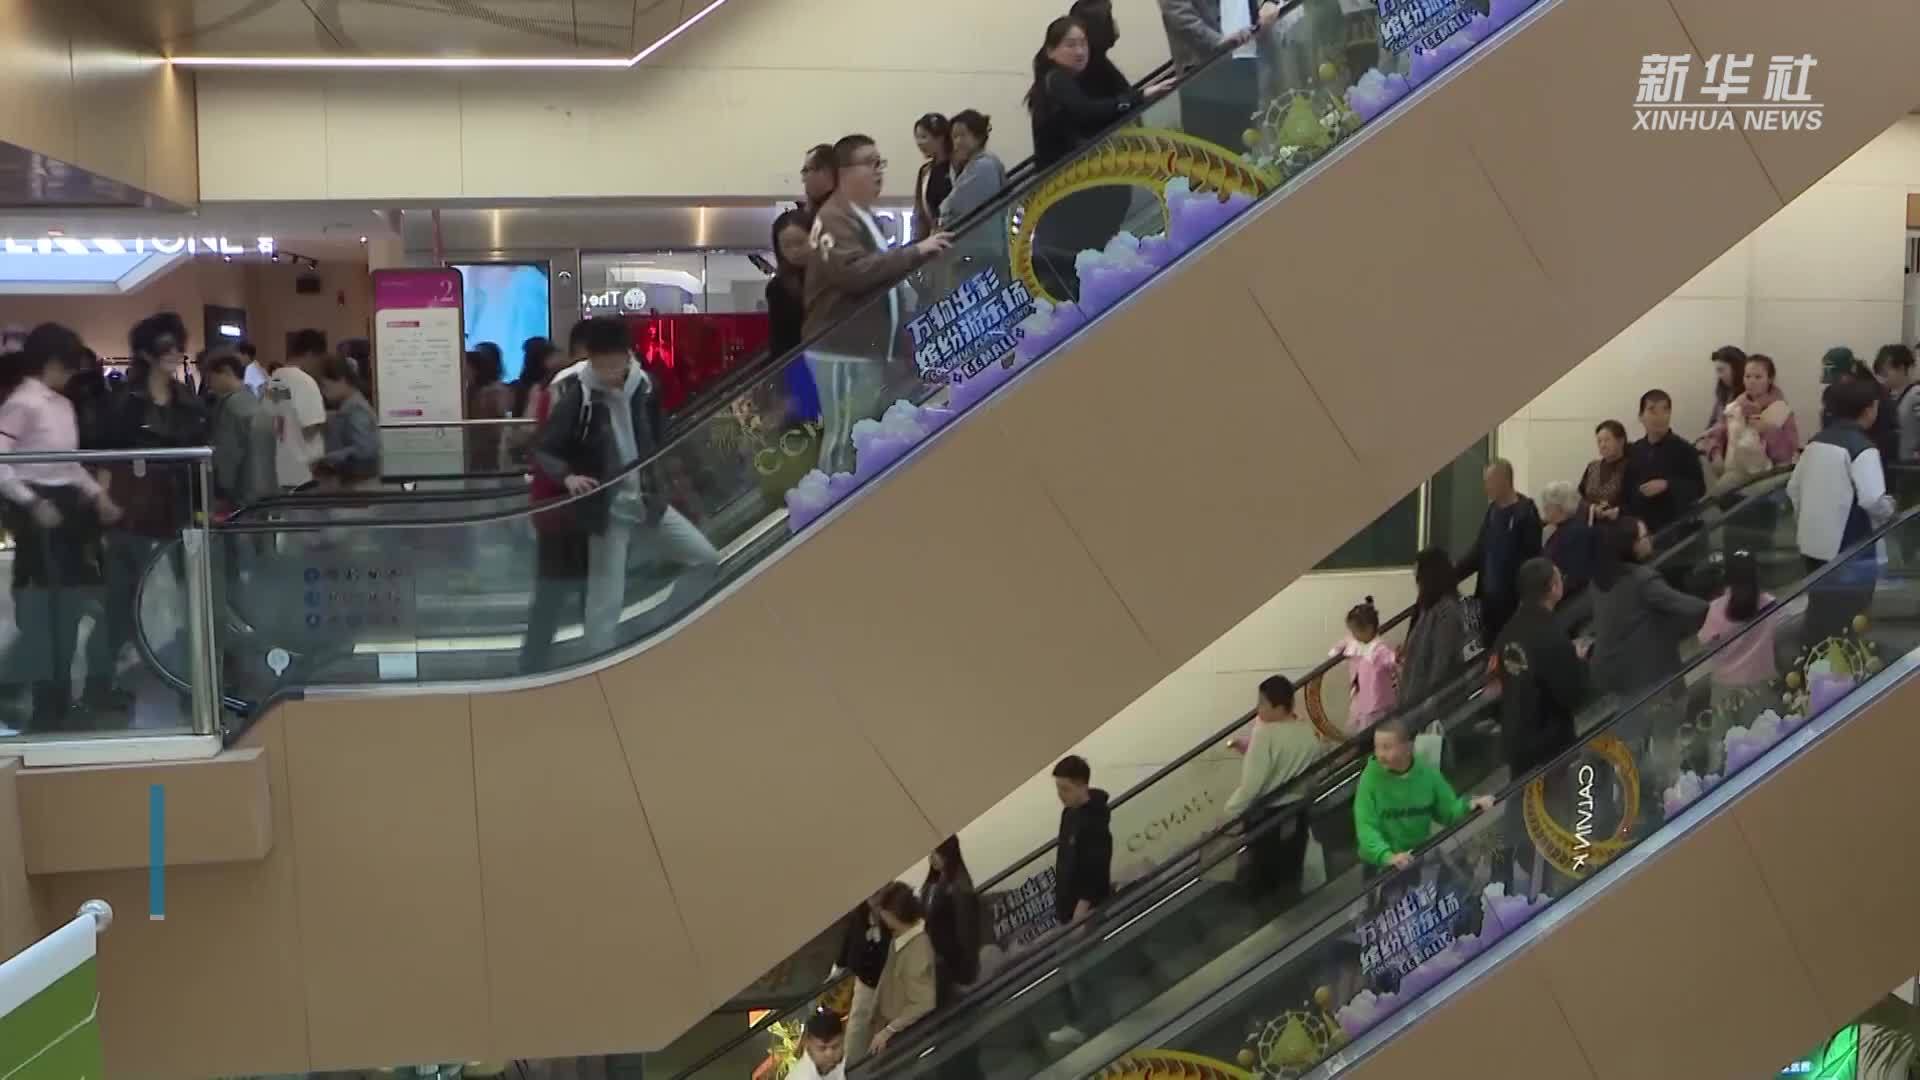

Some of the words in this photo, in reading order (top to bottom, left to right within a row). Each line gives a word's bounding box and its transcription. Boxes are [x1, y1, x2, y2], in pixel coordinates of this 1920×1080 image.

[905, 266, 1000, 345] 万物出彩
[914, 281, 1030, 376] 缤纷游乐场
[962, 334, 1018, 376] CCMALL
